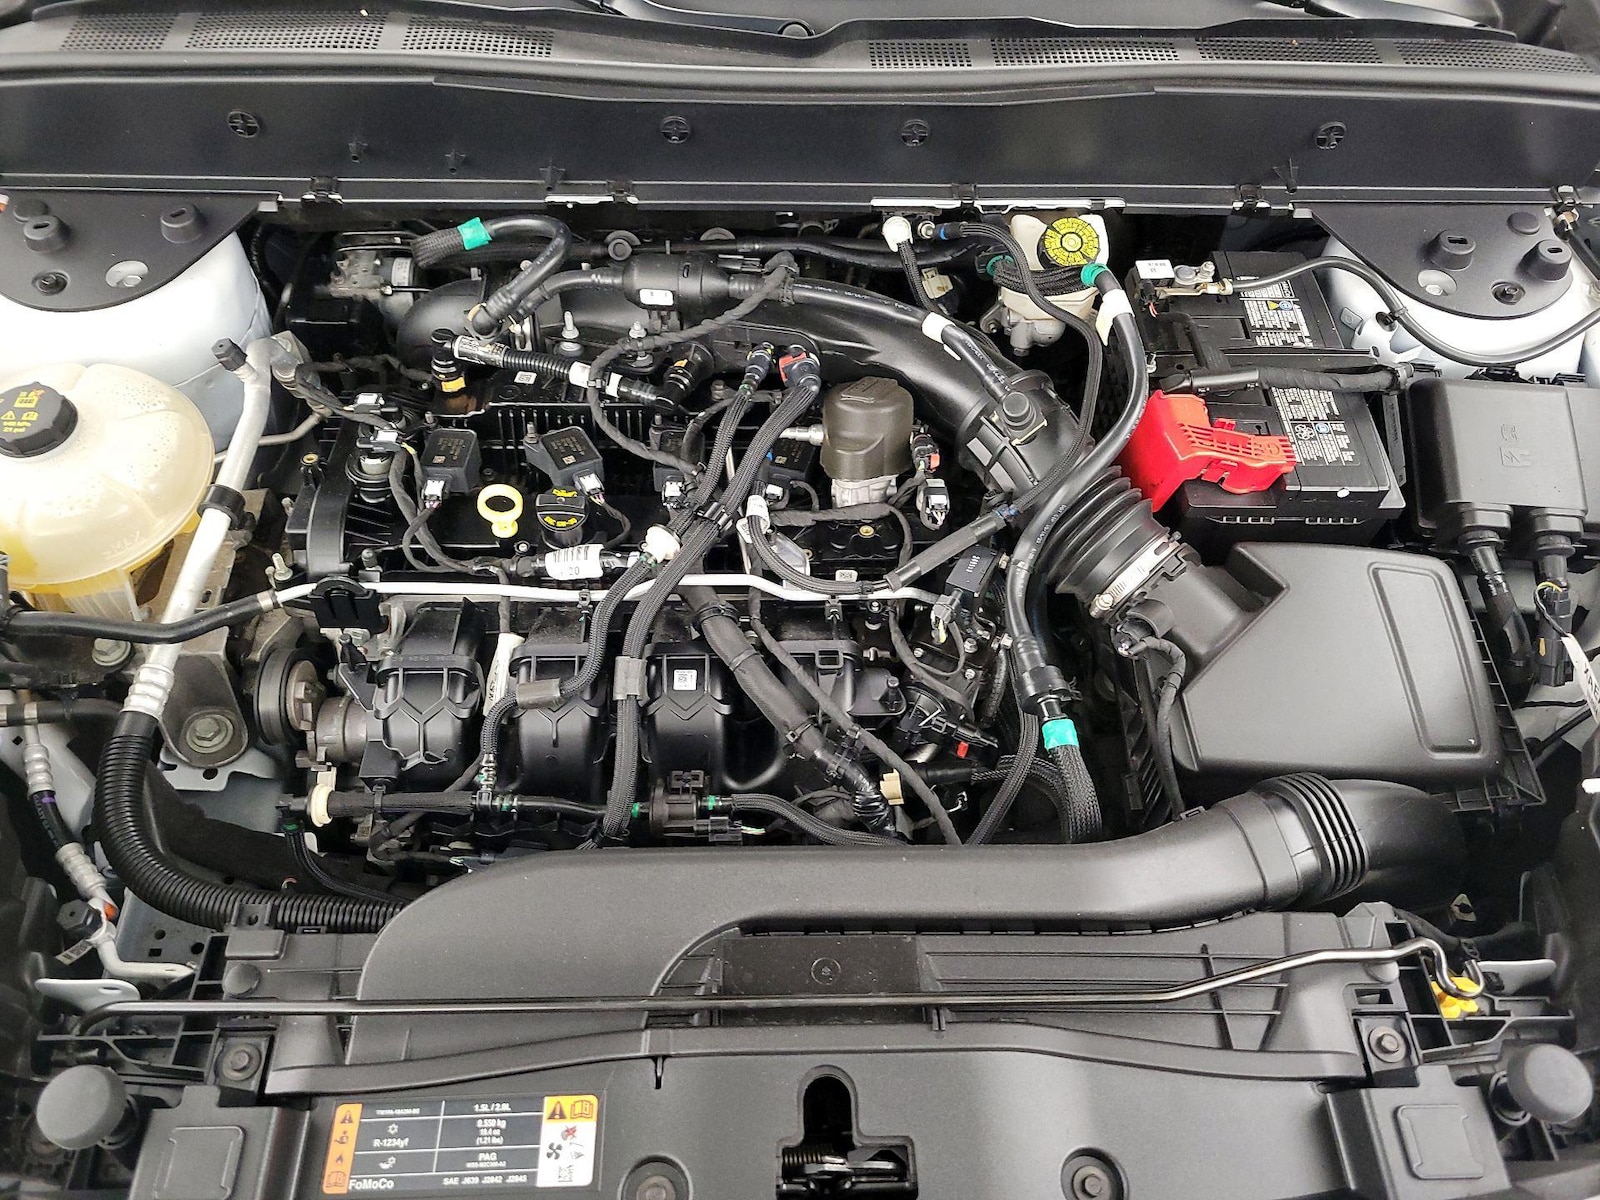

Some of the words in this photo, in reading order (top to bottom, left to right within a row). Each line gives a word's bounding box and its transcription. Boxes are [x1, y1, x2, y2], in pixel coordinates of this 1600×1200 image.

[474, 1103, 490, 1112] 1.5L
[373, 1137, 409, 1149] R-1234yf
[478, 1152, 498, 1161] PAG
[348, 1177, 395, 1190] FoMoCo
[443, 1177, 459, 1185] SAE
